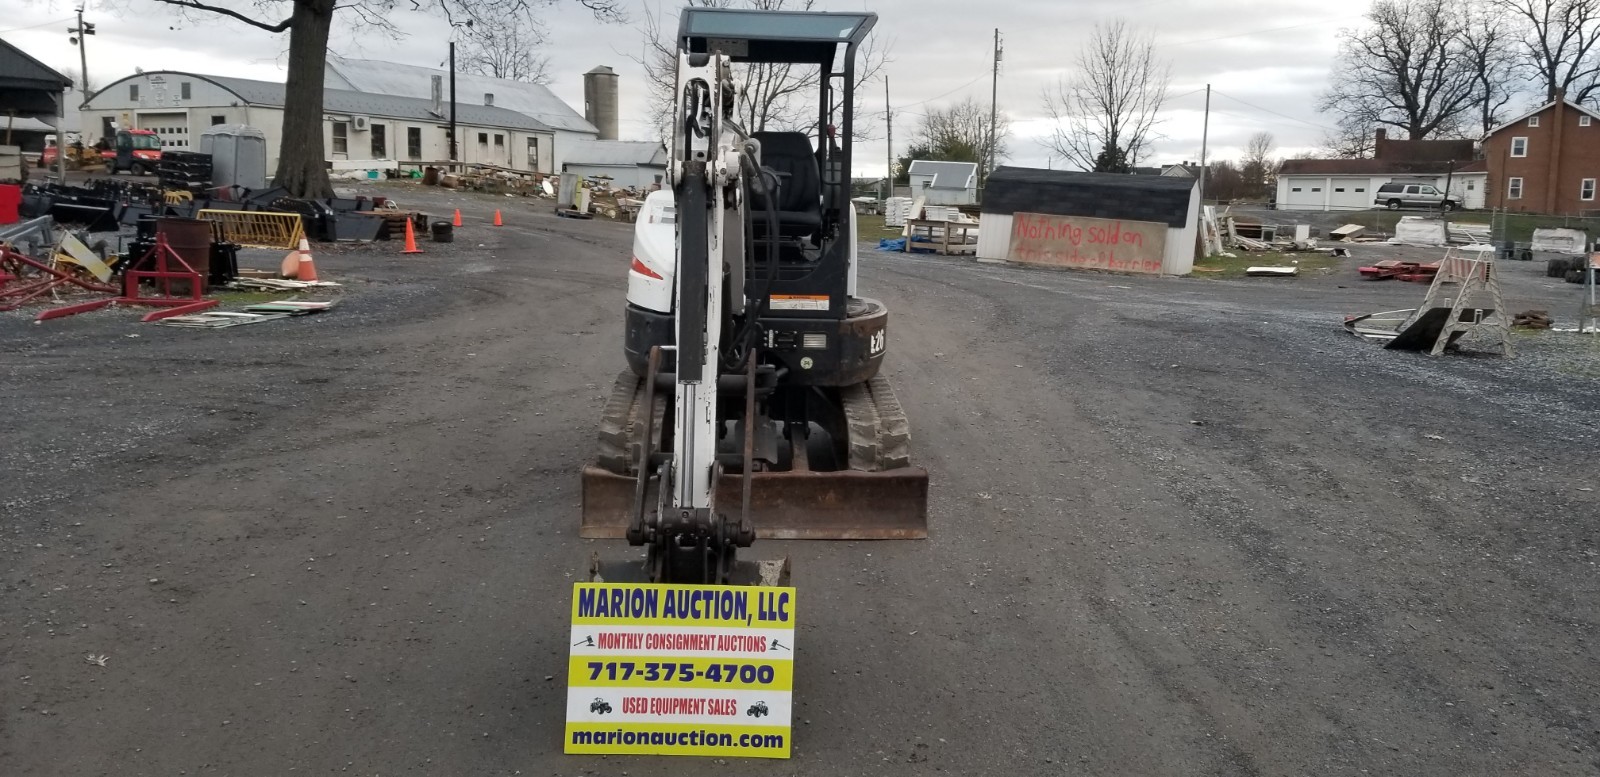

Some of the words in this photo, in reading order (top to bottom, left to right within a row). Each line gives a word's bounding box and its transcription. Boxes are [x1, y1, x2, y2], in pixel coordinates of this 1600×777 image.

[1017, 215, 1081, 246] Nothing
[1087, 221, 1121, 245] sold
[1109, 250, 1162, 271] barrier
[578, 588, 659, 619] MARION
[663, 589, 753, 626] AUCTION,
[758, 591, 789, 622] LLC
[598, 633, 644, 650] MONTHLY
[645, 633, 715, 651] CONSIGNMENT
[717, 635, 767, 652] AUCTIONS
[588, 662, 775, 684] 717-375-4700
[622, 697, 648, 714] USED
[650, 697, 706, 716] EQUIPMENT
[708, 698, 737, 716] SALES
[572, 729, 783, 748] marionauction.com
